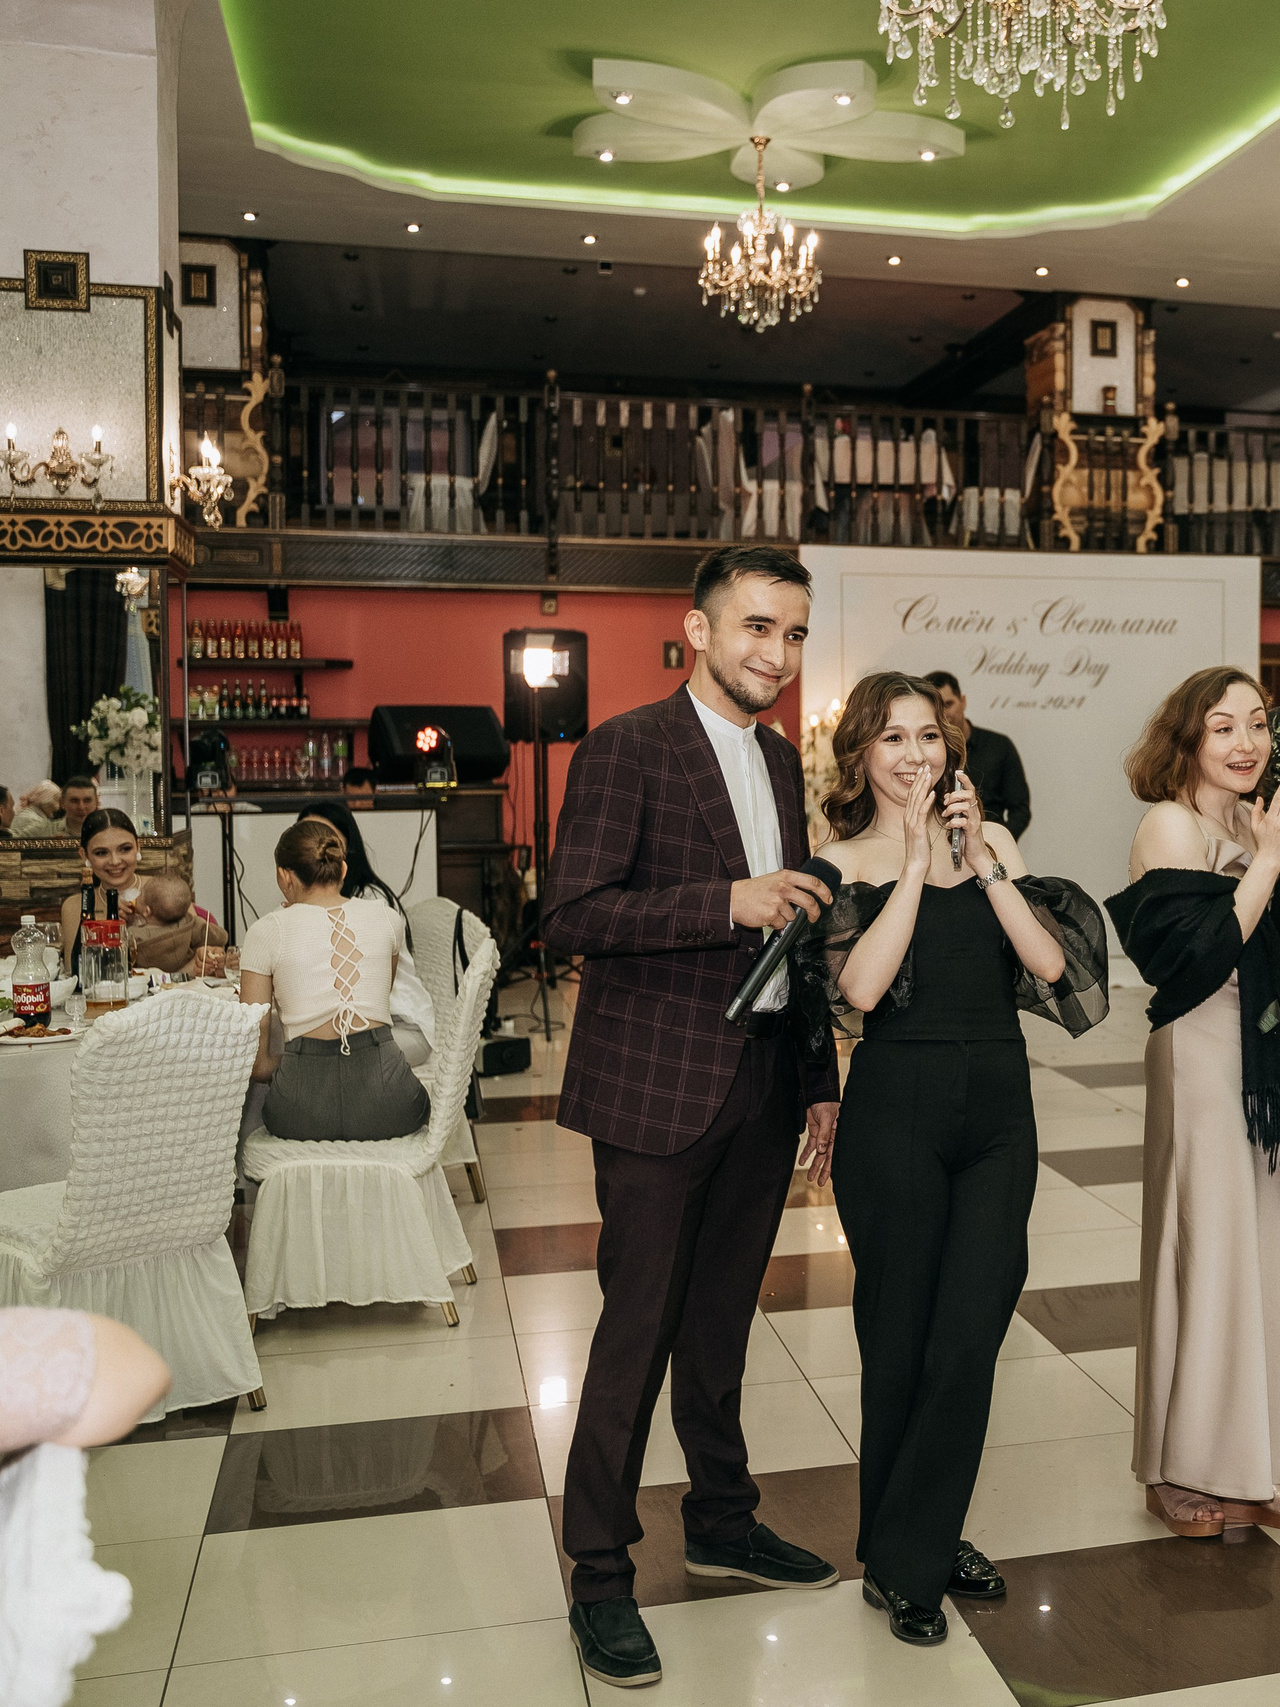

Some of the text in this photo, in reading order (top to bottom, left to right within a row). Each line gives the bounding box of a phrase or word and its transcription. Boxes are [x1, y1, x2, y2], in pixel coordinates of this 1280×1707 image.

[893, 594, 1178, 636] Семён & Светлана
[968, 647, 1110, 688] Wedding Day
[1040, 695, 1086, 710] 2024
[14, 991, 45, 1005] Добрый
